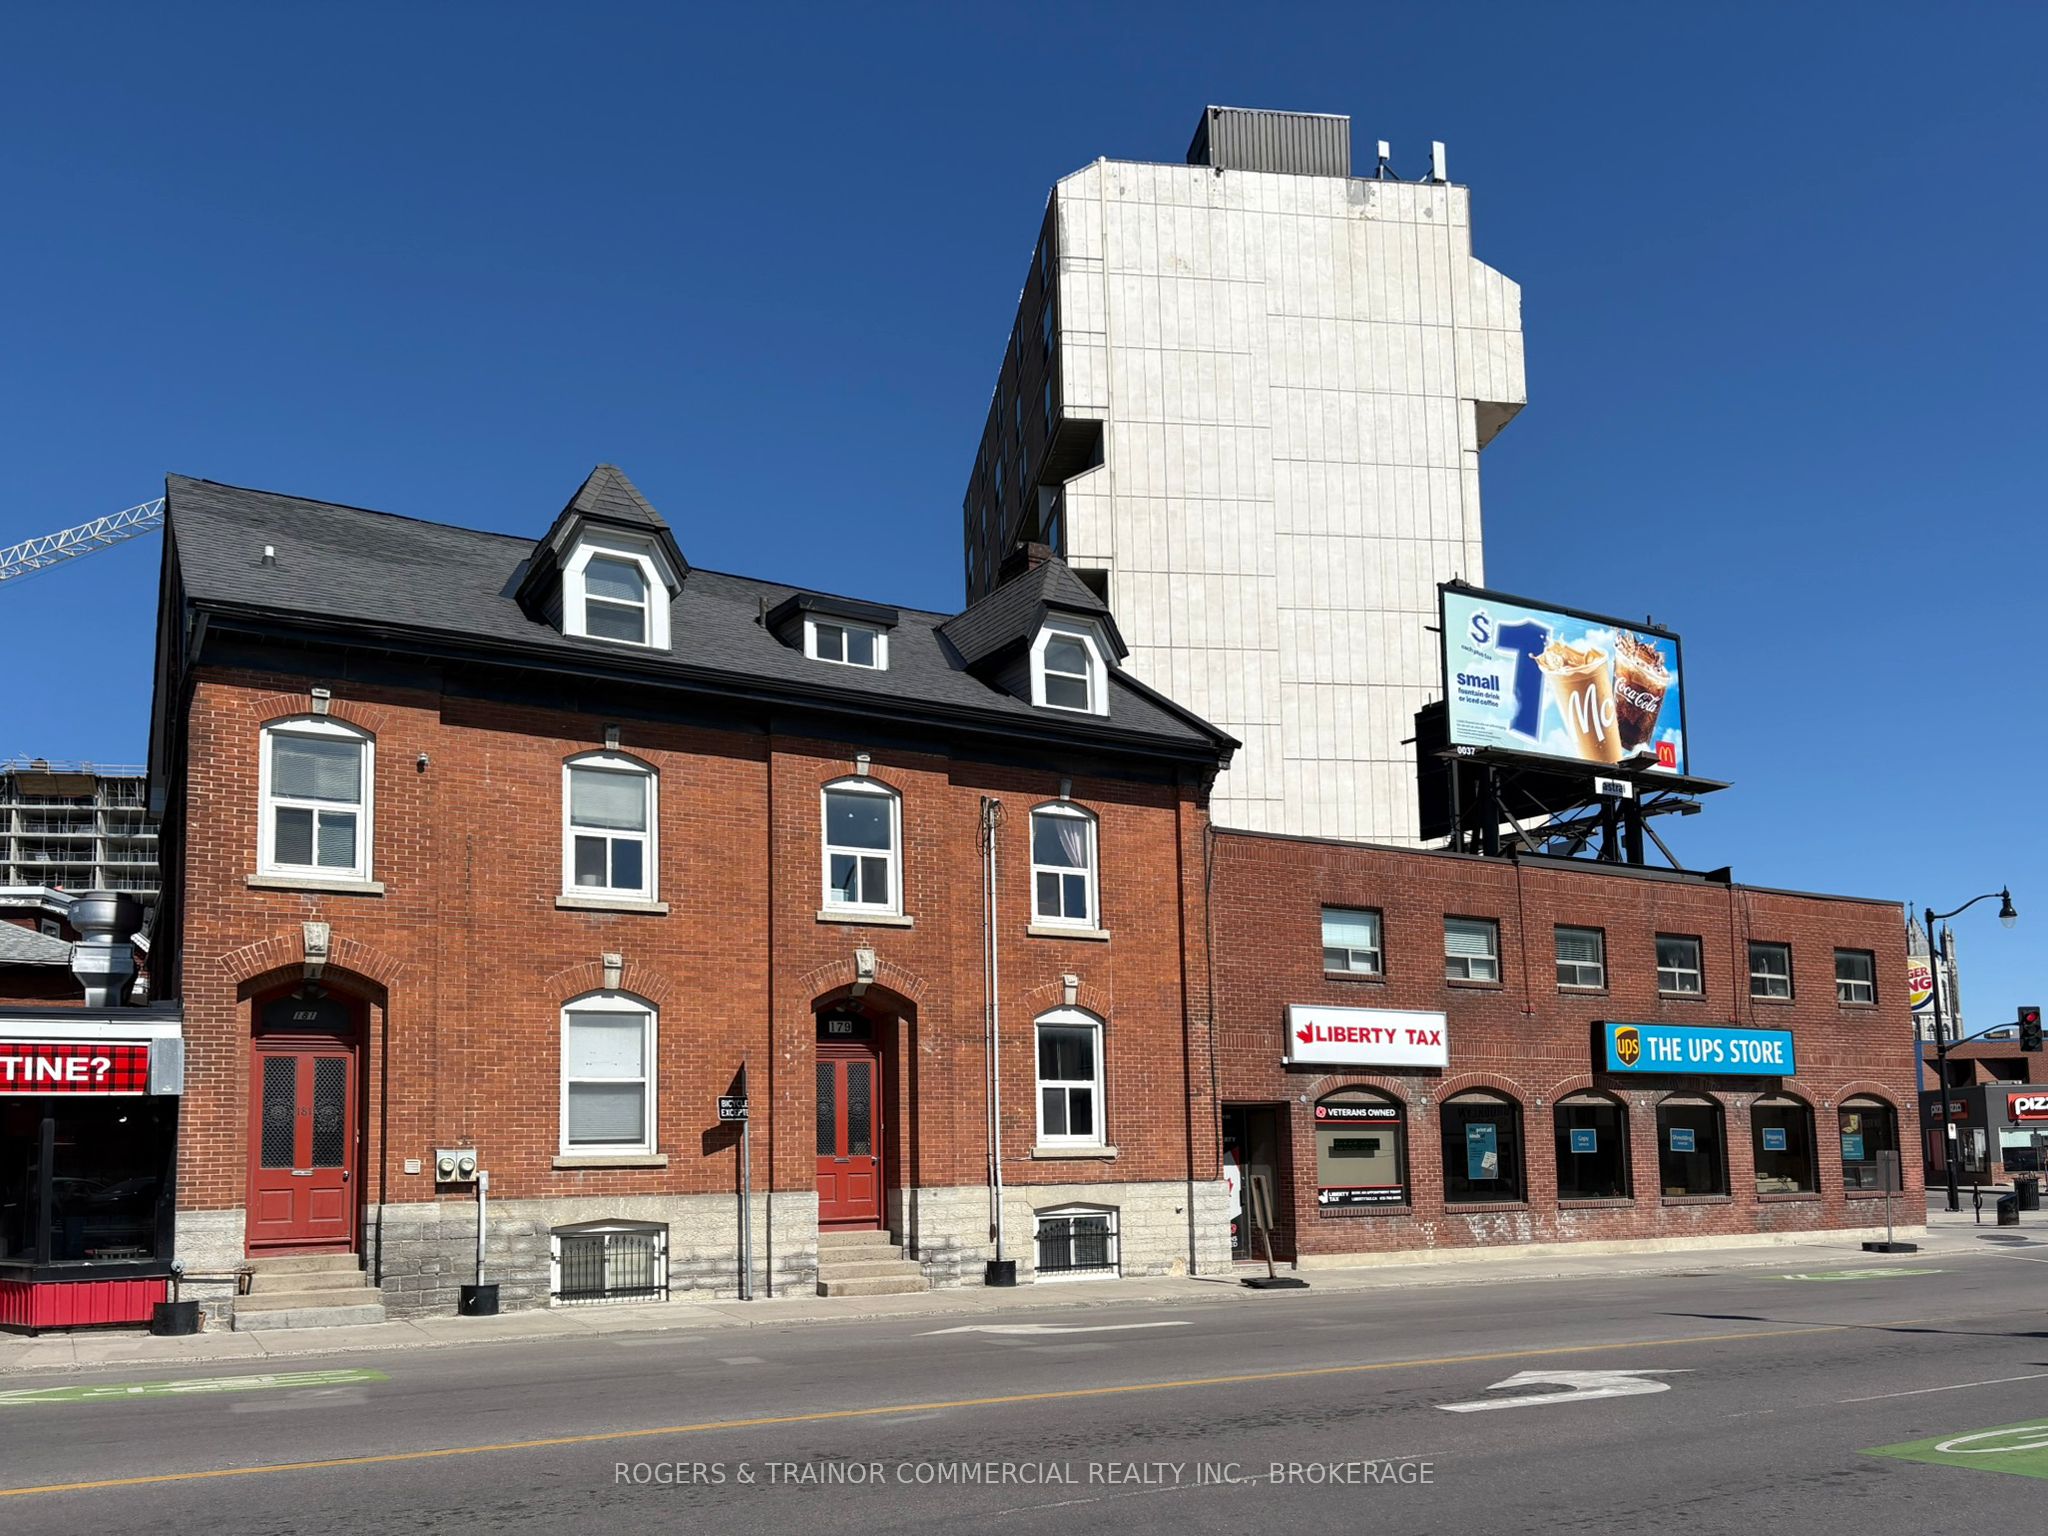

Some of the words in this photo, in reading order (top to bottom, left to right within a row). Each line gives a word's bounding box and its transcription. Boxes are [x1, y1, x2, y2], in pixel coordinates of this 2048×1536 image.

[1457, 672, 1499, 691] small
[1457, 746, 1475, 756] 0037
[1907, 967, 1928, 979] GER
[1908, 976, 1932, 992] NG
[830, 1021, 851, 1032] 179
[1316, 1025, 1396, 1044] LIBERTY
[1405, 1029, 1441, 1046] TAX
[1618, 1039, 1639, 1061] ups
[1647, 1037, 1682, 1062] THE
[1688, 1038, 1724, 1062] UPS
[1730, 1040, 1784, 1064] STORE
[0, 1056, 111, 1081] TINE?
[721, 1099, 748, 1108] BICYCLE
[721, 1108, 748, 1117] EXCEPTE
[1328, 1108, 1367, 1117] VETERANS
[1367, 1108, 1396, 1117] OWNED
